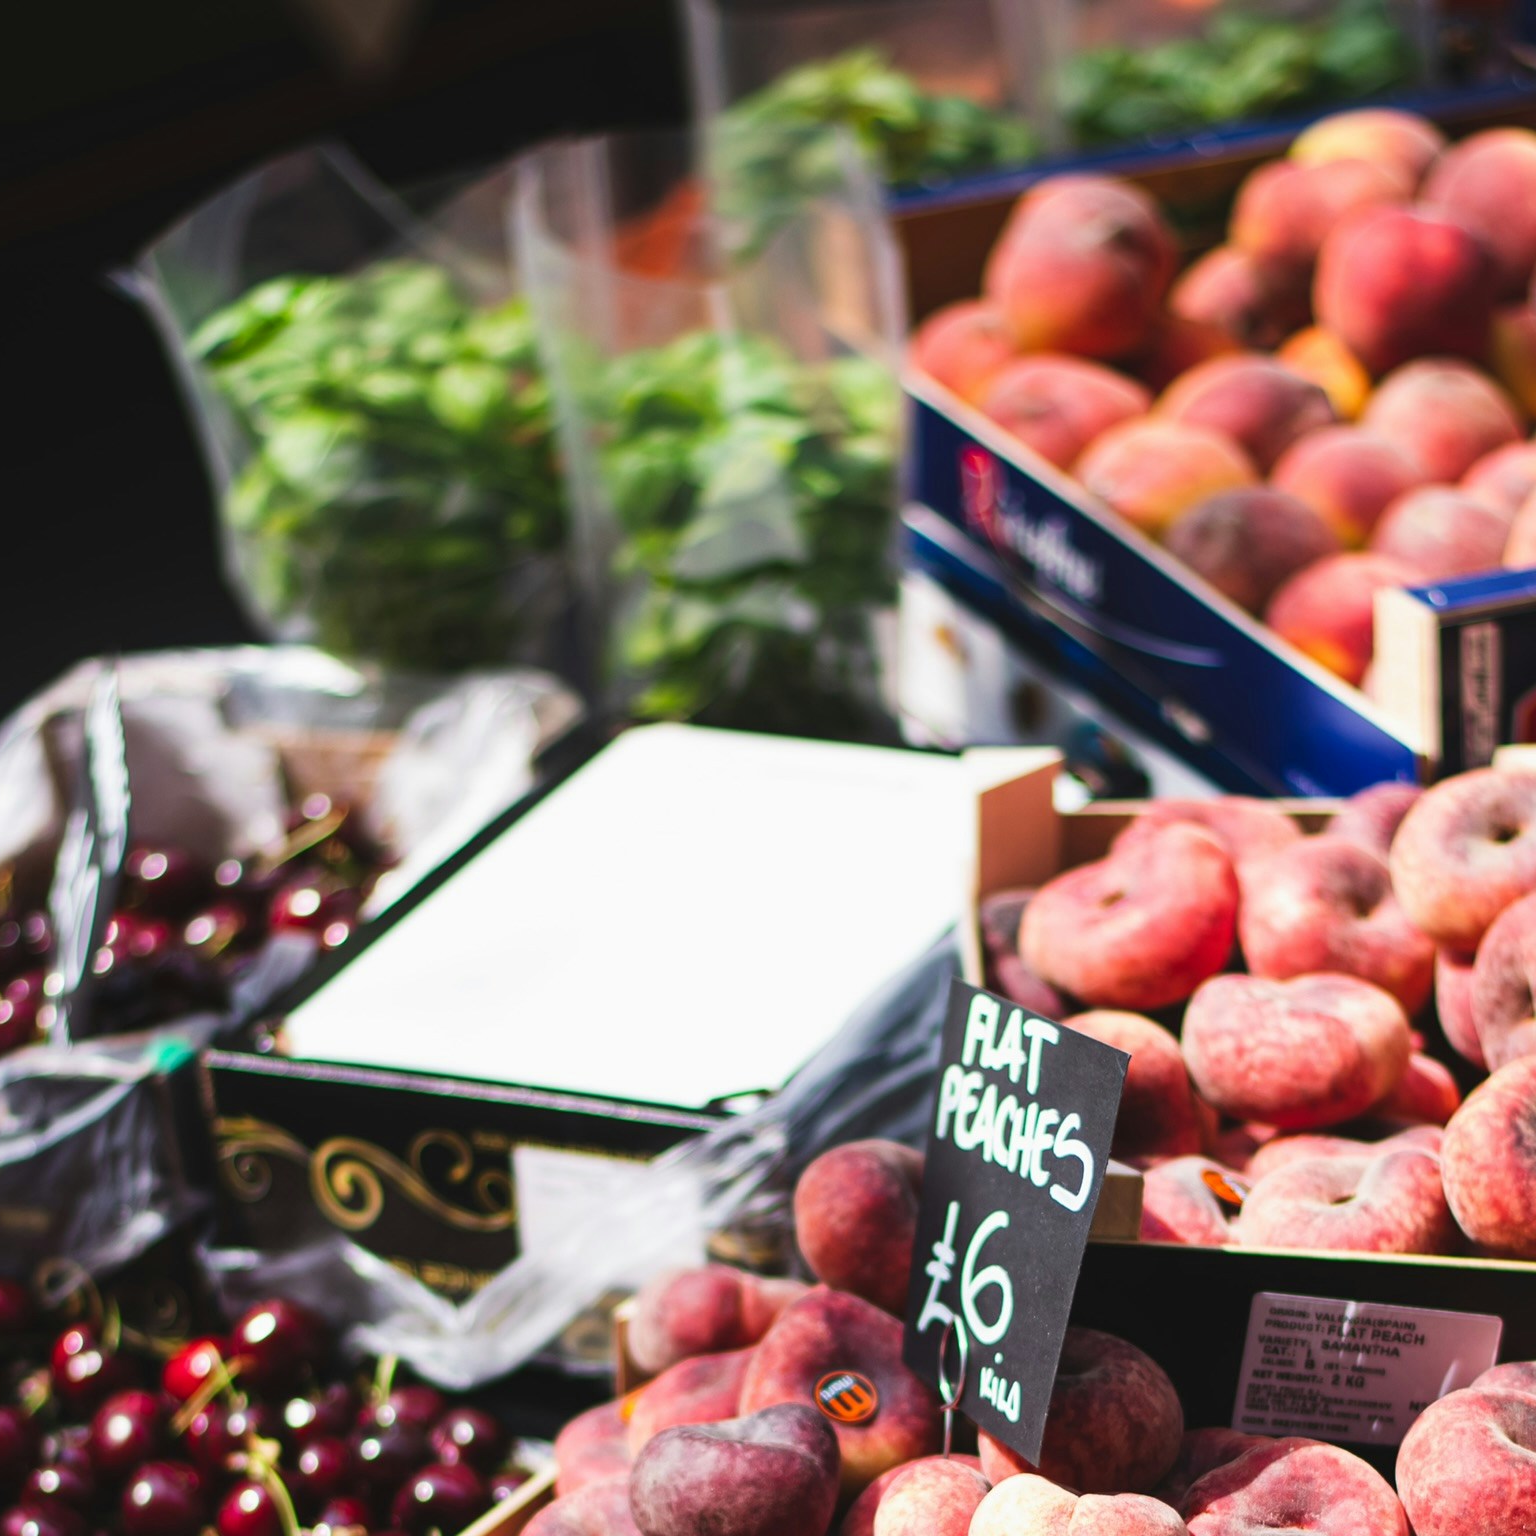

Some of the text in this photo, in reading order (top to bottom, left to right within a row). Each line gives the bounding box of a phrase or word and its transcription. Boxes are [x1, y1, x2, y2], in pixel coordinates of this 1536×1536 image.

[962, 992, 1060, 1096] FLAT
[935, 1063, 1096, 1213] PEACHES
[1264, 1318, 1426, 1346] PRODUCT: FLAT PEACH
[1321, 1338, 1401, 1358] SAMANTHA
[1345, 1375, 1366, 1390] KG
